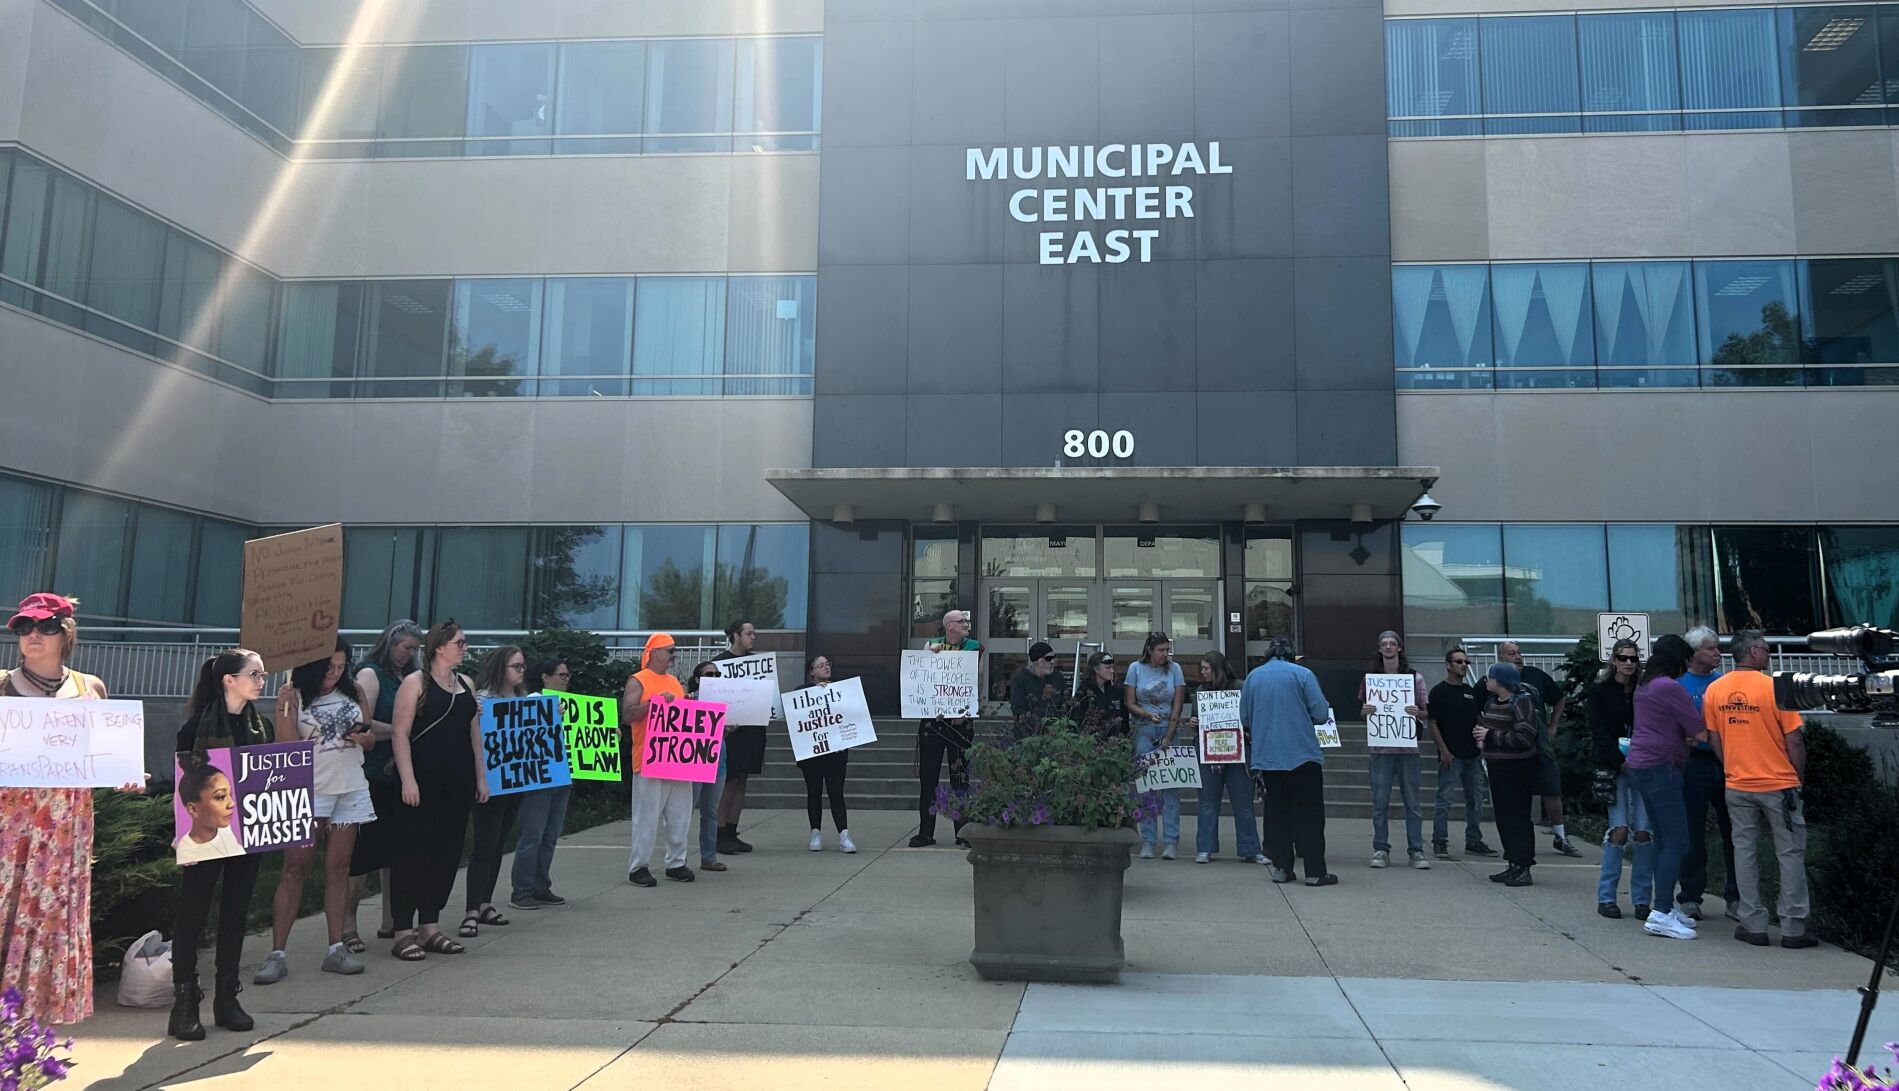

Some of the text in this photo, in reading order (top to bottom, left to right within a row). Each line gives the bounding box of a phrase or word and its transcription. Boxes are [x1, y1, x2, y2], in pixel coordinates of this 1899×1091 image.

[966, 142, 1233, 180] MUNICIPAL
[1009, 186, 1194, 222] CENTER
[1039, 230, 1159, 264] EAST
[1063, 429, 1135, 458] 800
[723, 658, 774, 679] JUSTICE
[907, 655, 963, 671] THE POWER
[909, 669, 971, 685] OF THE PEOPLE
[1367, 677, 1412, 689] JUSTICE
[917, 684, 974, 698] IS STRONGER
[1368, 688, 1412, 704] MUST
[808, 702, 832, 719] and
[920, 707, 929, 717] IN
[931, 696, 945, 707] THE
[947, 697, 973, 708] PEOPLE
[1383, 703, 1395, 713] BE
[492, 698, 554, 731] THIN
[587, 700, 605, 726] IS
[648, 703, 725, 737] FARLEY
[797, 713, 844, 733] justice
[0, 706, 142, 743] YOU AREN'T BEING
[1369, 713, 1417, 740] SERVED
[43, 733, 77, 747] VERY
[484, 723, 564, 771] BLURRY
[575, 727, 617, 750] ABOVE
[813, 731, 829, 743] for
[813, 740, 831, 755] all
[1316, 729, 1338, 746] AW
[577, 749, 621, 774] LAW.
[646, 736, 720, 766] STRONG
[1156, 757, 1176, 768] FOR
[265, 770, 287, 791] for
[501, 759, 553, 790] LINE
[242, 787, 313, 826] SONYA
[243, 817, 313, 848] MASSEY
